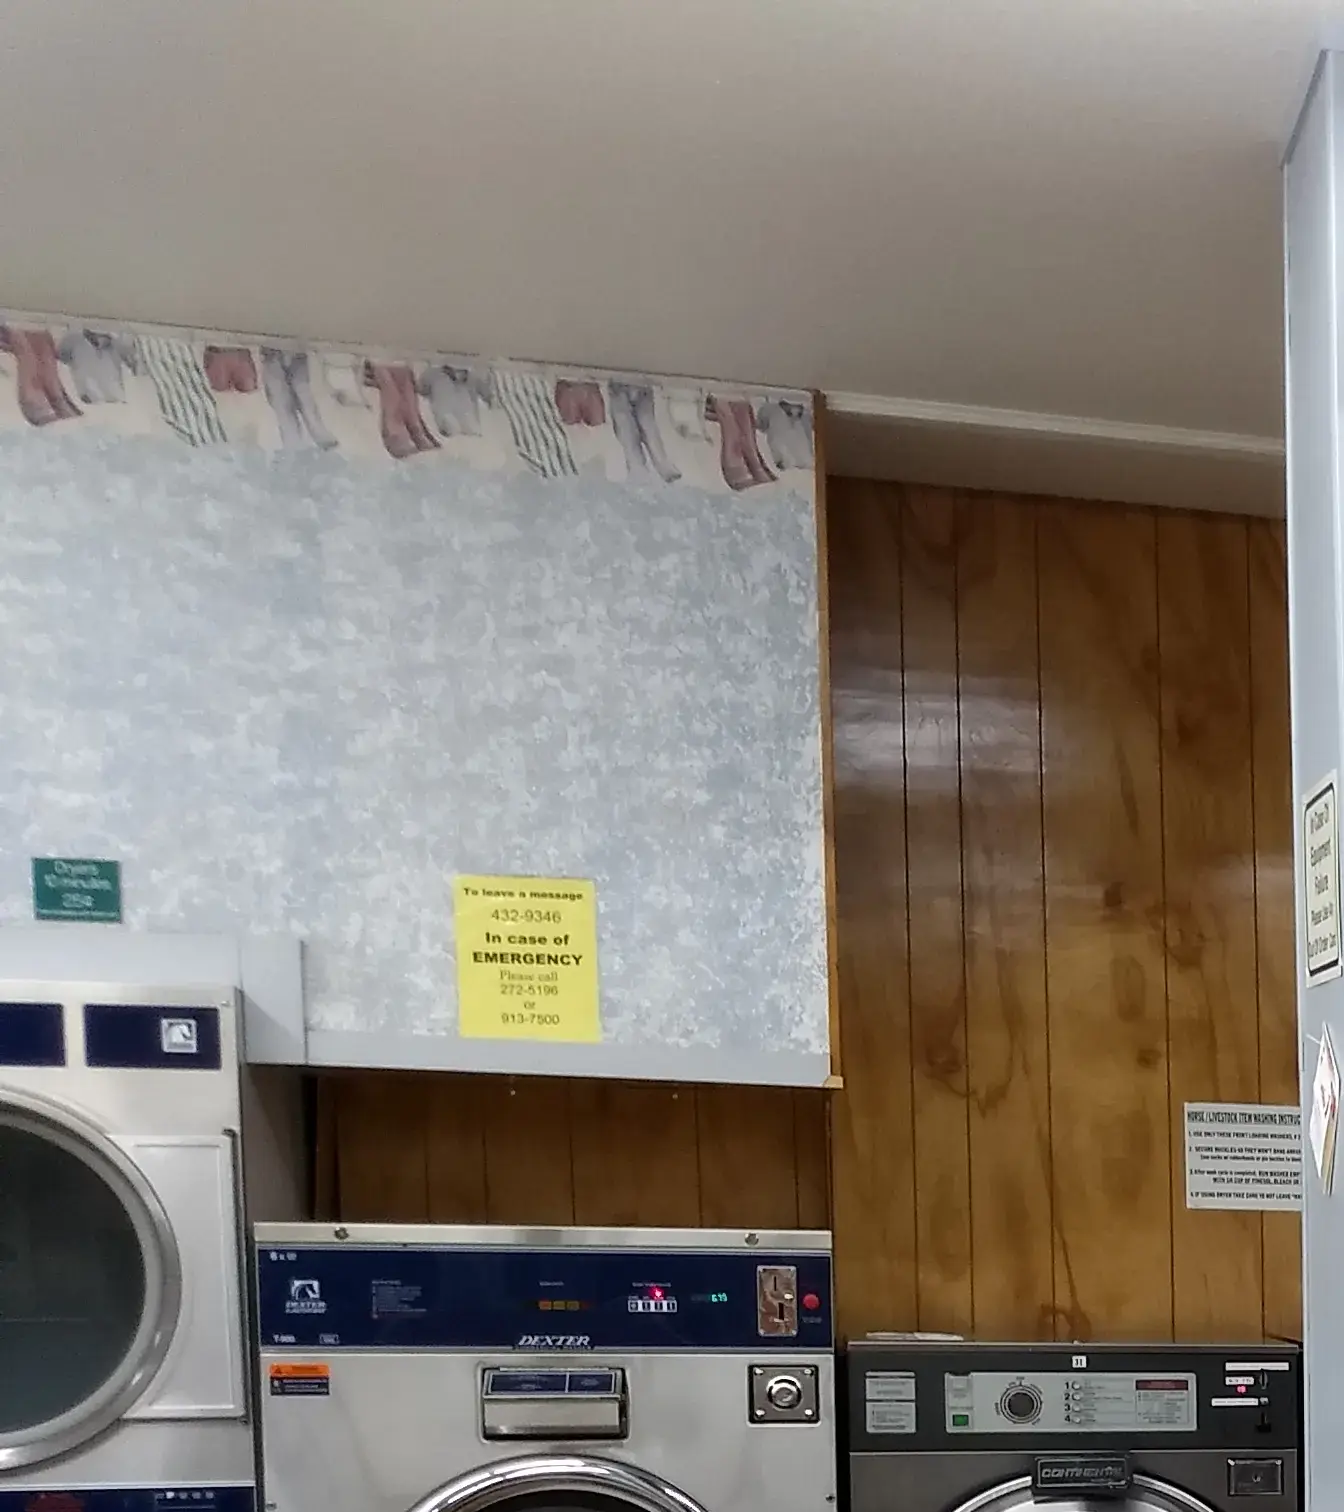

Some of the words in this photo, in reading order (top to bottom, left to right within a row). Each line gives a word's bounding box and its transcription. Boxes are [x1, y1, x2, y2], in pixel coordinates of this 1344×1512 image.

[464, 888, 478, 896] To
[482, 888, 514, 898] leave
[530, 892, 583, 901] message
[492, 910, 562, 923] 432-9346
[486, 932, 501, 944] In
[508, 935, 547, 946] case
[554, 934, 570, 946] of
[472, 952, 583, 966] EMERGENCY
[500, 970, 534, 981] Please
[538, 971, 558, 982] call
[502, 1012, 560, 1025] 913-7500
[518, 1336, 590, 1346] DEXTER
[1065, 1382, 1070, 1390] 1
[1064, 1403, 1070, 1411] 3
